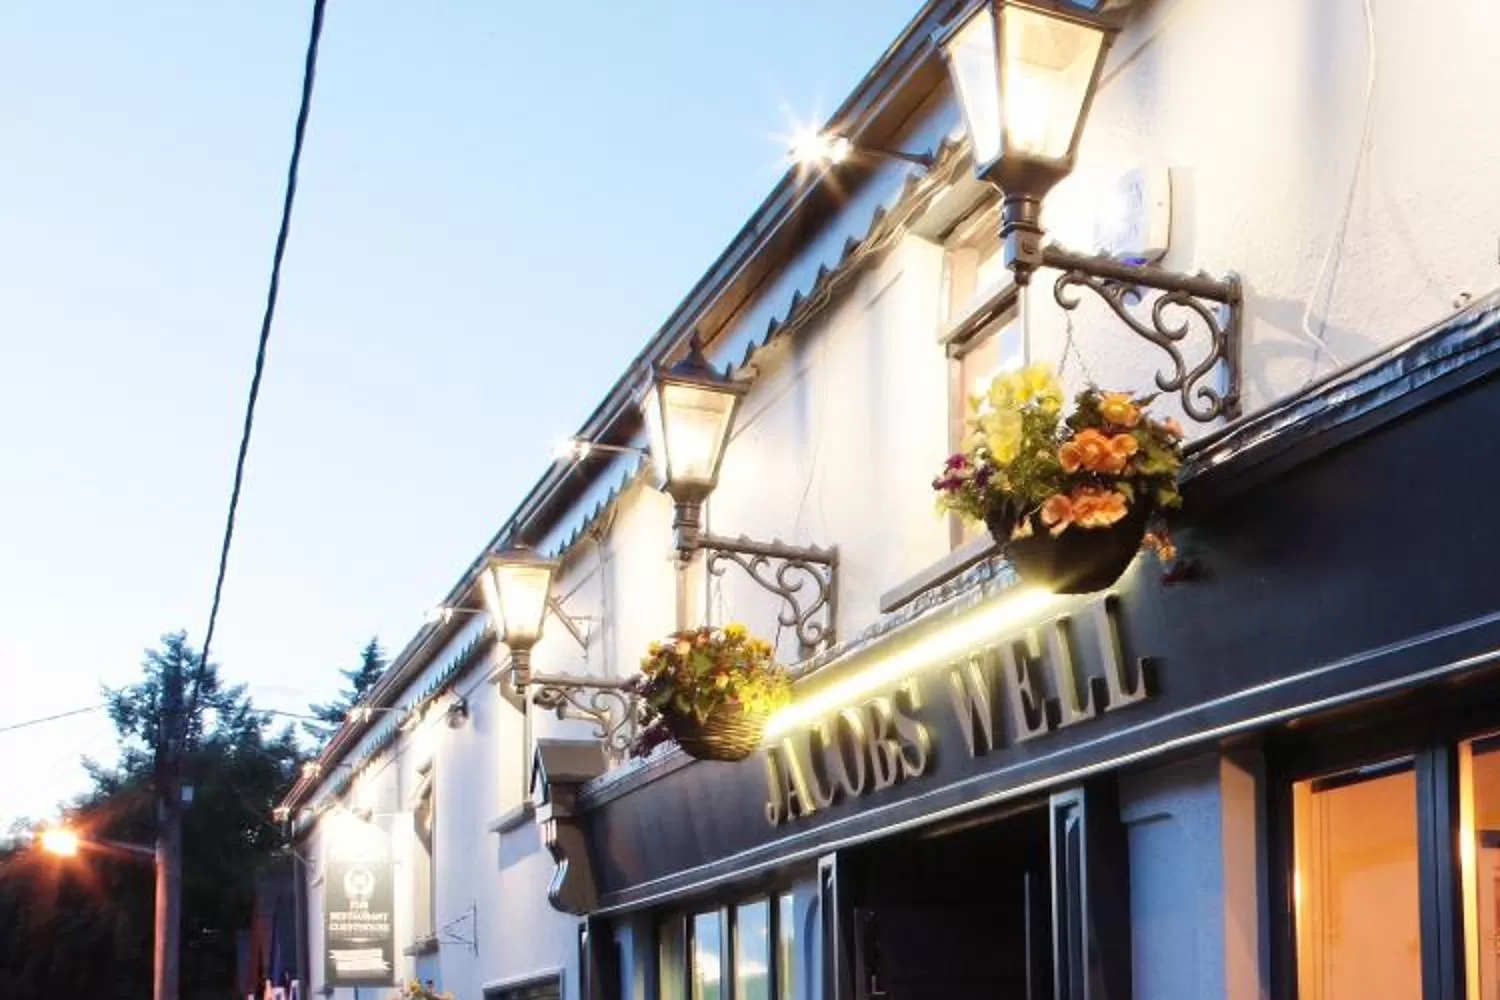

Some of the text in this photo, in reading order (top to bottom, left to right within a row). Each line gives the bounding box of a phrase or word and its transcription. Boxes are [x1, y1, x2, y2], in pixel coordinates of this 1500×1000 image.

[765, 593, 1146, 827] JACOBS WELL
[329, 911, 389, 922] RESTAURANT
